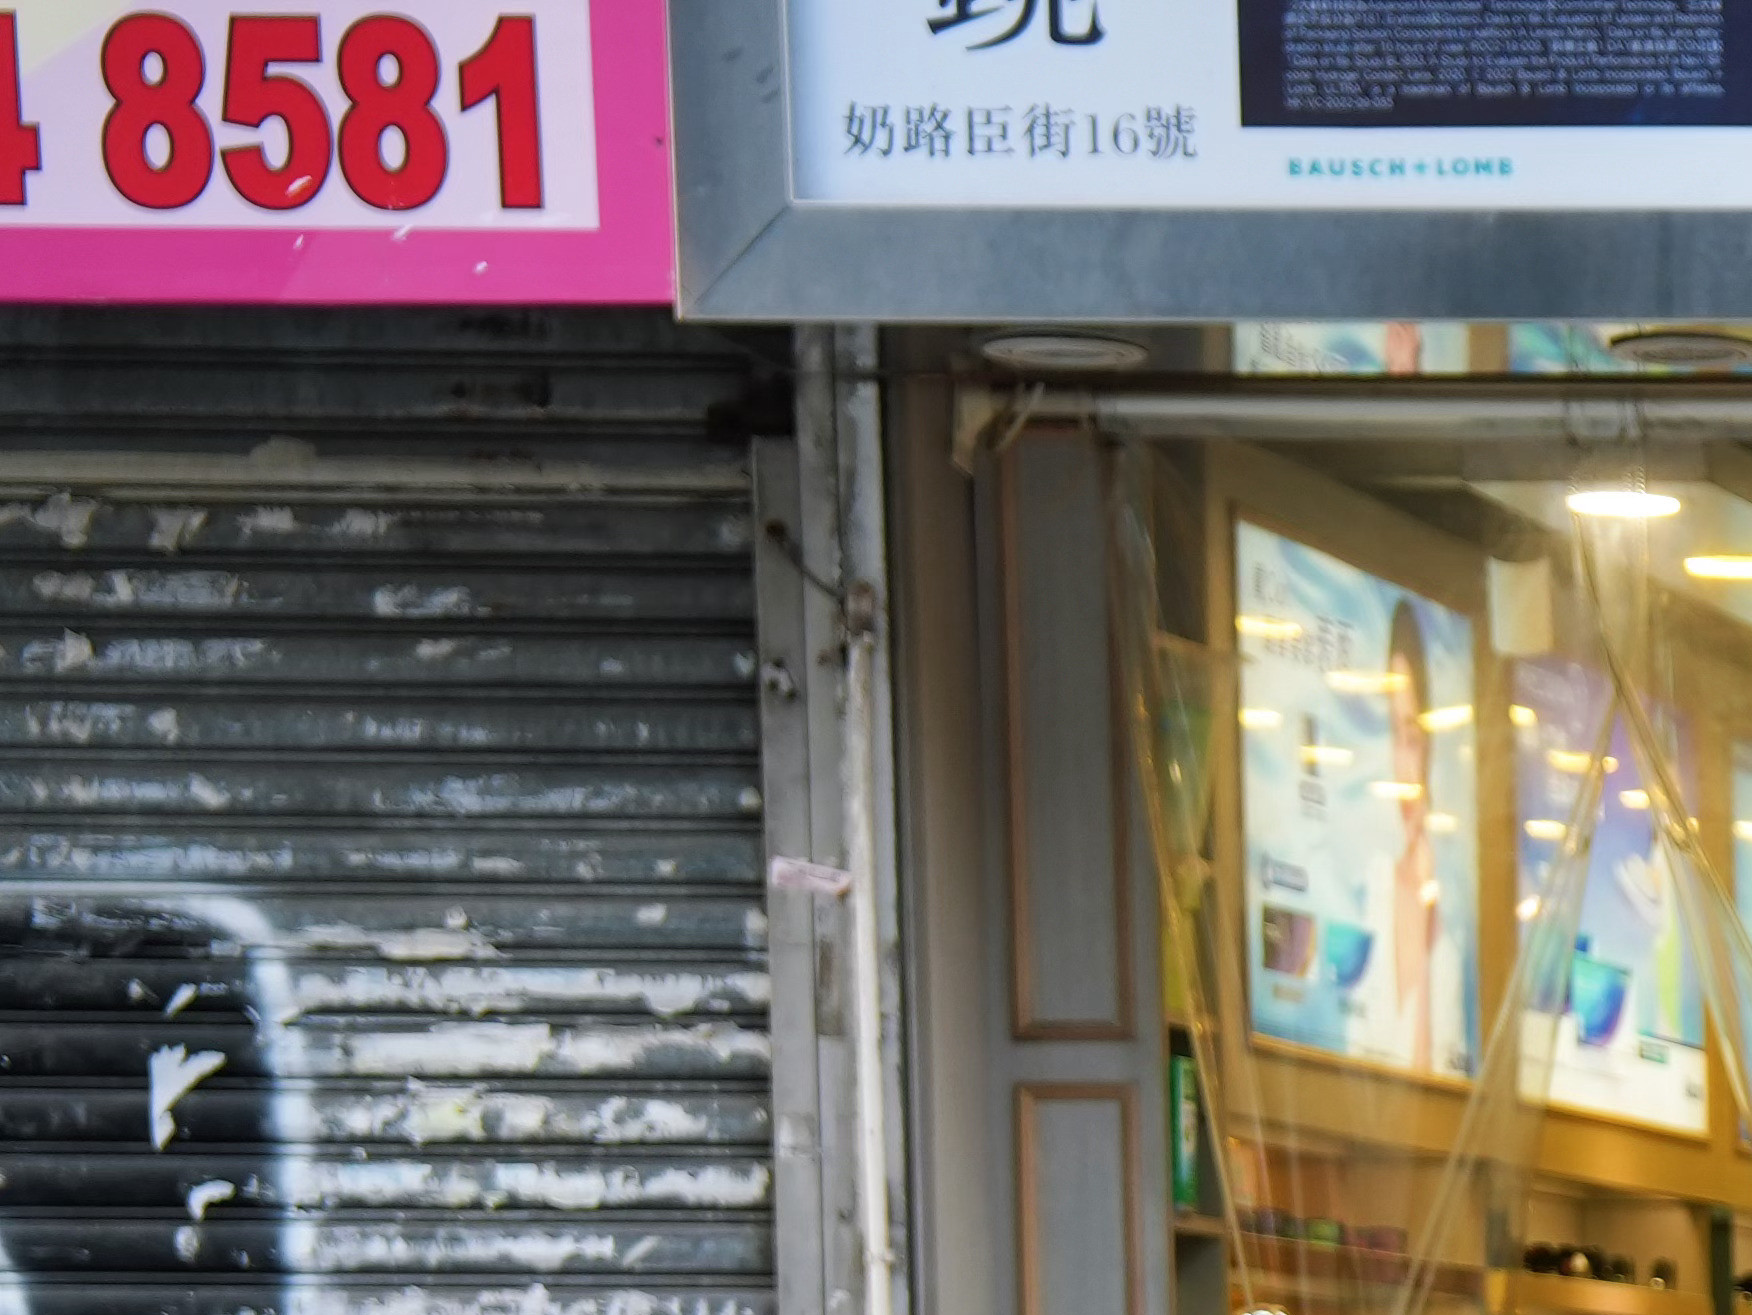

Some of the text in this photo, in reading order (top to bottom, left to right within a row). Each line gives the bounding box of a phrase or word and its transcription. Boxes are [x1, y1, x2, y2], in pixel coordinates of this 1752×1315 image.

[102, 10, 546, 211] 8581
[842, 100, 1198, 159] 奶路臣街16號
